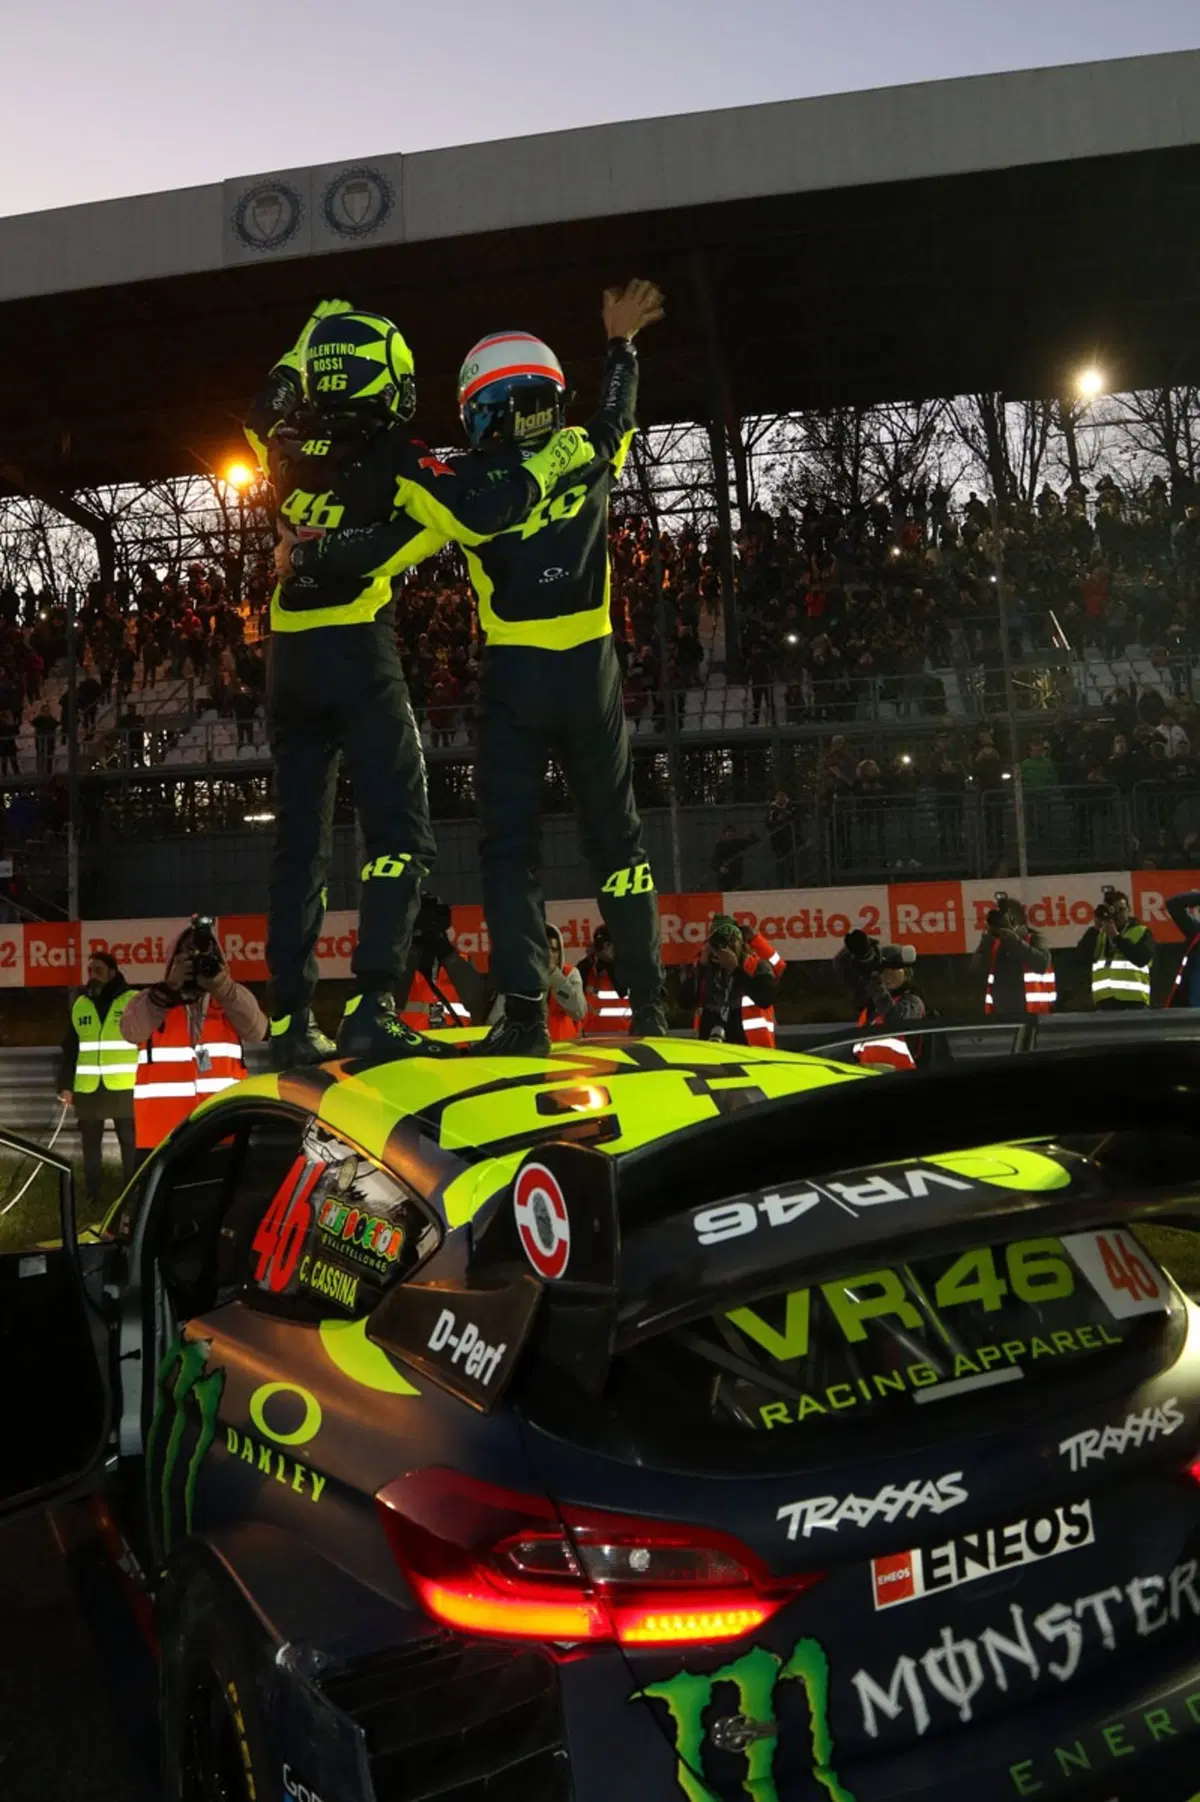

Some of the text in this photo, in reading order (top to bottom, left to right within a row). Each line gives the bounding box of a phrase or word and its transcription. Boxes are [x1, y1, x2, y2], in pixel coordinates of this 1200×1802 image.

[309, 343, 355, 358] LENTINO
[313, 357, 343, 372] ROSSI
[316, 374, 348, 392] 46
[301, 439, 331, 456] 46
[281, 488, 344, 529] 46
[602, 863, 654, 897] 46
[858, 905, 881, 937] 2
[896, 900, 957, 934] Rai
[1, 934, 265, 968] 2 Rai Radi Ra
[252, 1154, 328, 1293] 46
[299, 1255, 360, 1308] C. CASSINA
[1096, 1234, 1160, 1303] 46
[427, 1308, 507, 1386] D-Perf
[760, 1323, 1124, 1430] RACING APPAREL
[1059, 1397, 1185, 1472] TRAXXAS
[226, 1427, 326, 1502] OAKLEY
[776, 1471, 969, 1540] TRAXXAS
[922, 1499, 1093, 1591] ENEOS
[877, 1567, 911, 1586] ENEOS
[851, 1559, 1200, 1738] MONSTER
